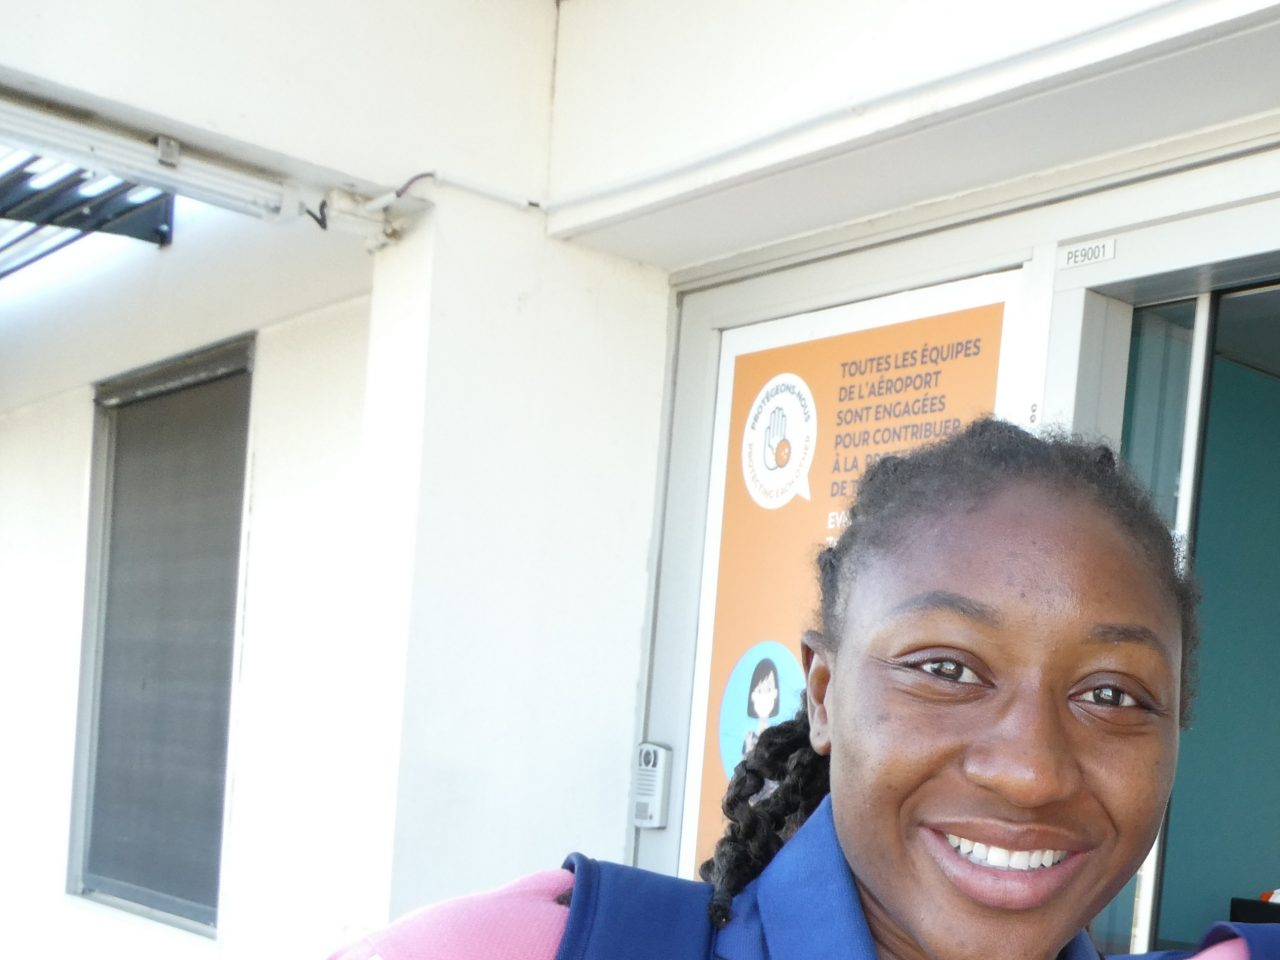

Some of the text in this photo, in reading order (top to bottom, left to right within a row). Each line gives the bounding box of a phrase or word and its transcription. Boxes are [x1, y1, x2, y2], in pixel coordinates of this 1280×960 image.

[1066, 243, 1106, 265] PE9001
[840, 338, 982, 379] TOUTES LES ÉQUIPES
[838, 371, 942, 403] DE L'AÉROPORT
[836, 394, 946, 427] SONT ENGAGÉES
[834, 418, 962, 449] POUR CONTRIBUER
[831, 452, 841, 475] À
[843, 455, 859, 472] LA
[831, 481, 848, 498] DE
